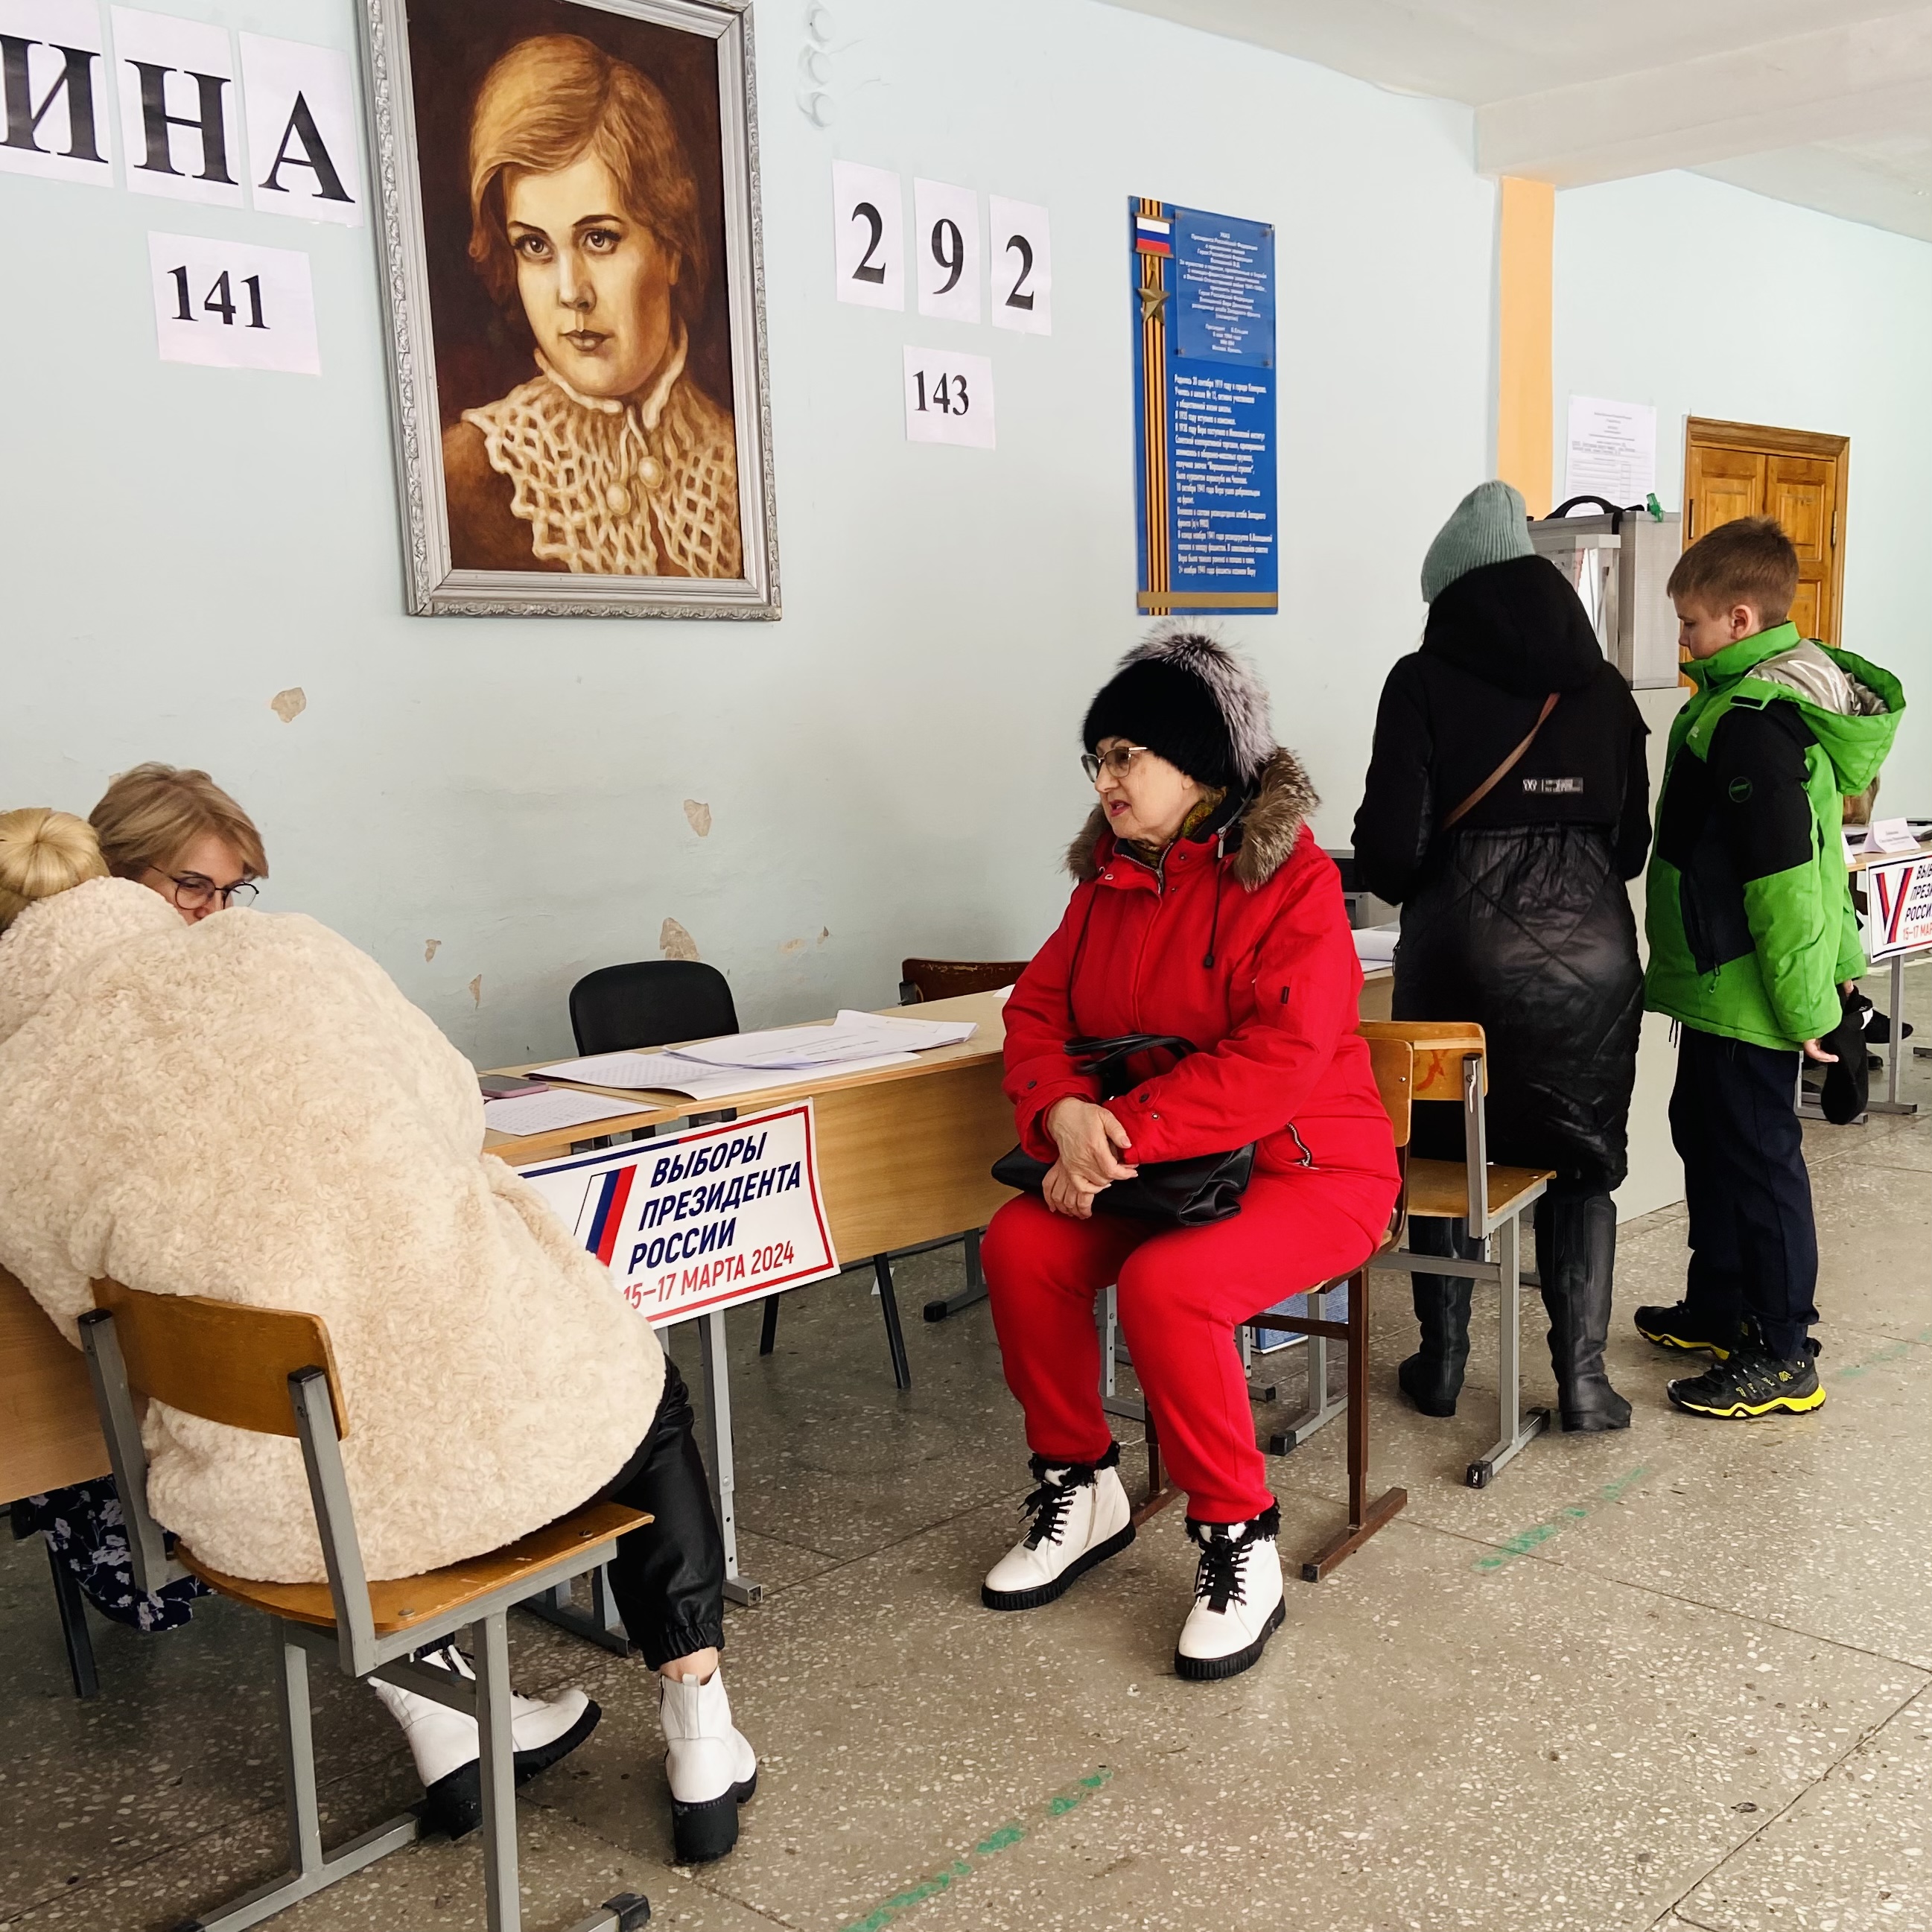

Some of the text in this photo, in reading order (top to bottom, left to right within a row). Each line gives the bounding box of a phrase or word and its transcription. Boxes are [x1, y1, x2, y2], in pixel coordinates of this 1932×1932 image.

[167, 264, 270, 330] 141
[912, 370, 969, 416] 143
[650, 1131, 768, 1189] ВЫБОРЫ
[638, 1160, 801, 1232] ПРЕЗИДЕНТА
[628, 1216, 737, 1275] РОССИИ
[681, 1253, 746, 1296] МАРТА
[750, 1240, 795, 1276] 2024
